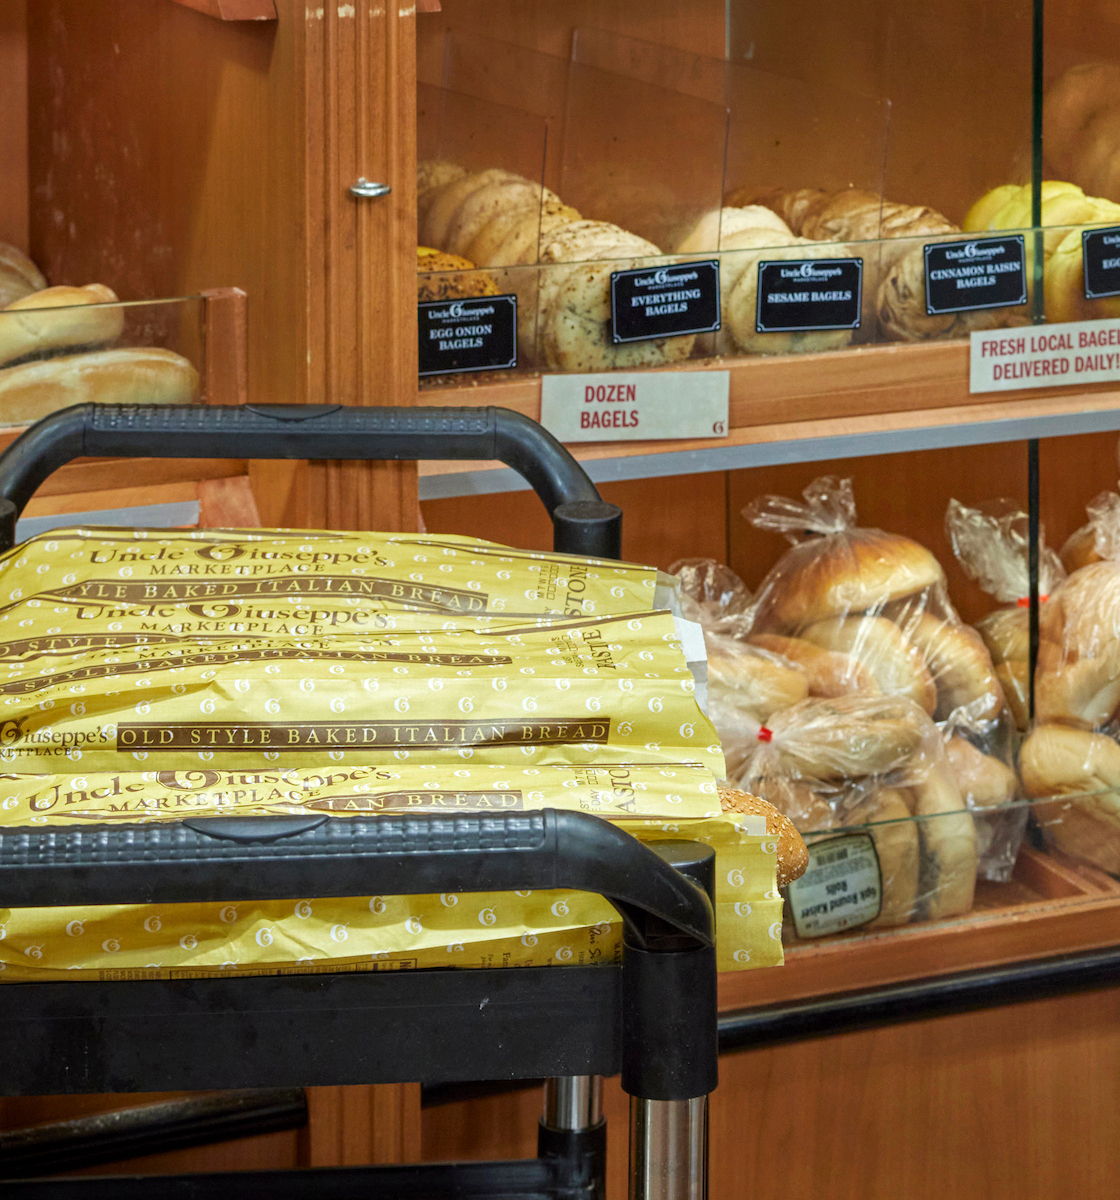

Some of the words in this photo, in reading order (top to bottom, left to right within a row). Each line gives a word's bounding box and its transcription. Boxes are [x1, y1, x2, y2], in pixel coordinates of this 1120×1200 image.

[930, 264, 985, 280] CINNAMON
[986, 261, 1021, 275] RAISIN
[956, 275, 997, 290] BAGELS
[631, 288, 701, 308] EVERYTHING
[767, 291, 810, 303] SESAME
[811, 290, 852, 302] BAGELS
[645, 301, 688, 317] BAGELS
[429, 328, 454, 340] EGG
[455, 324, 493, 337] ONION
[439, 337, 484, 351] BAGELS
[981, 337, 1026, 358] FRESH
[1031, 333, 1074, 353] LOCAL
[993, 357, 1070, 381] DELIVERED
[1075, 353, 1120, 373] DAILY!
[585, 384, 636, 403] DOZEN
[580, 410, 639, 430] BAGELS
[89, 547, 184, 563] Uncle
[194, 544, 388, 567] Giuseppe's
[149, 563, 326, 576] MARKETPLACE
[143, 583, 239, 599] BAKED
[254, 578, 375, 594] ITALIAN
[390, 584, 485, 613] BREAD
[563, 565, 588, 616] STONE
[76, 604, 176, 619] Uncle
[186, 604, 389, 628] Giuseppe's
[140, 621, 325, 636] MARKETPLACE
[28, 636, 118, 651] STYLE
[25, 666, 117, 691] STYLE
[136, 653, 240, 670] BAKED
[259, 650, 388, 660] ITALIAN
[408, 654, 507, 664] BREAD
[0, 715, 109, 747] Giuseppe's
[120, 729, 175, 744] OLD
[190, 728, 272, 744] STYLE
[287, 728, 377, 744] BAKED
[393, 726, 505, 742] ITALIAN
[520, 723, 606, 740] BREAD
[26, 776, 146, 812] Uncle
[109, 787, 321, 812] MARKETPLACE
[407, 793, 519, 809] BREAD
